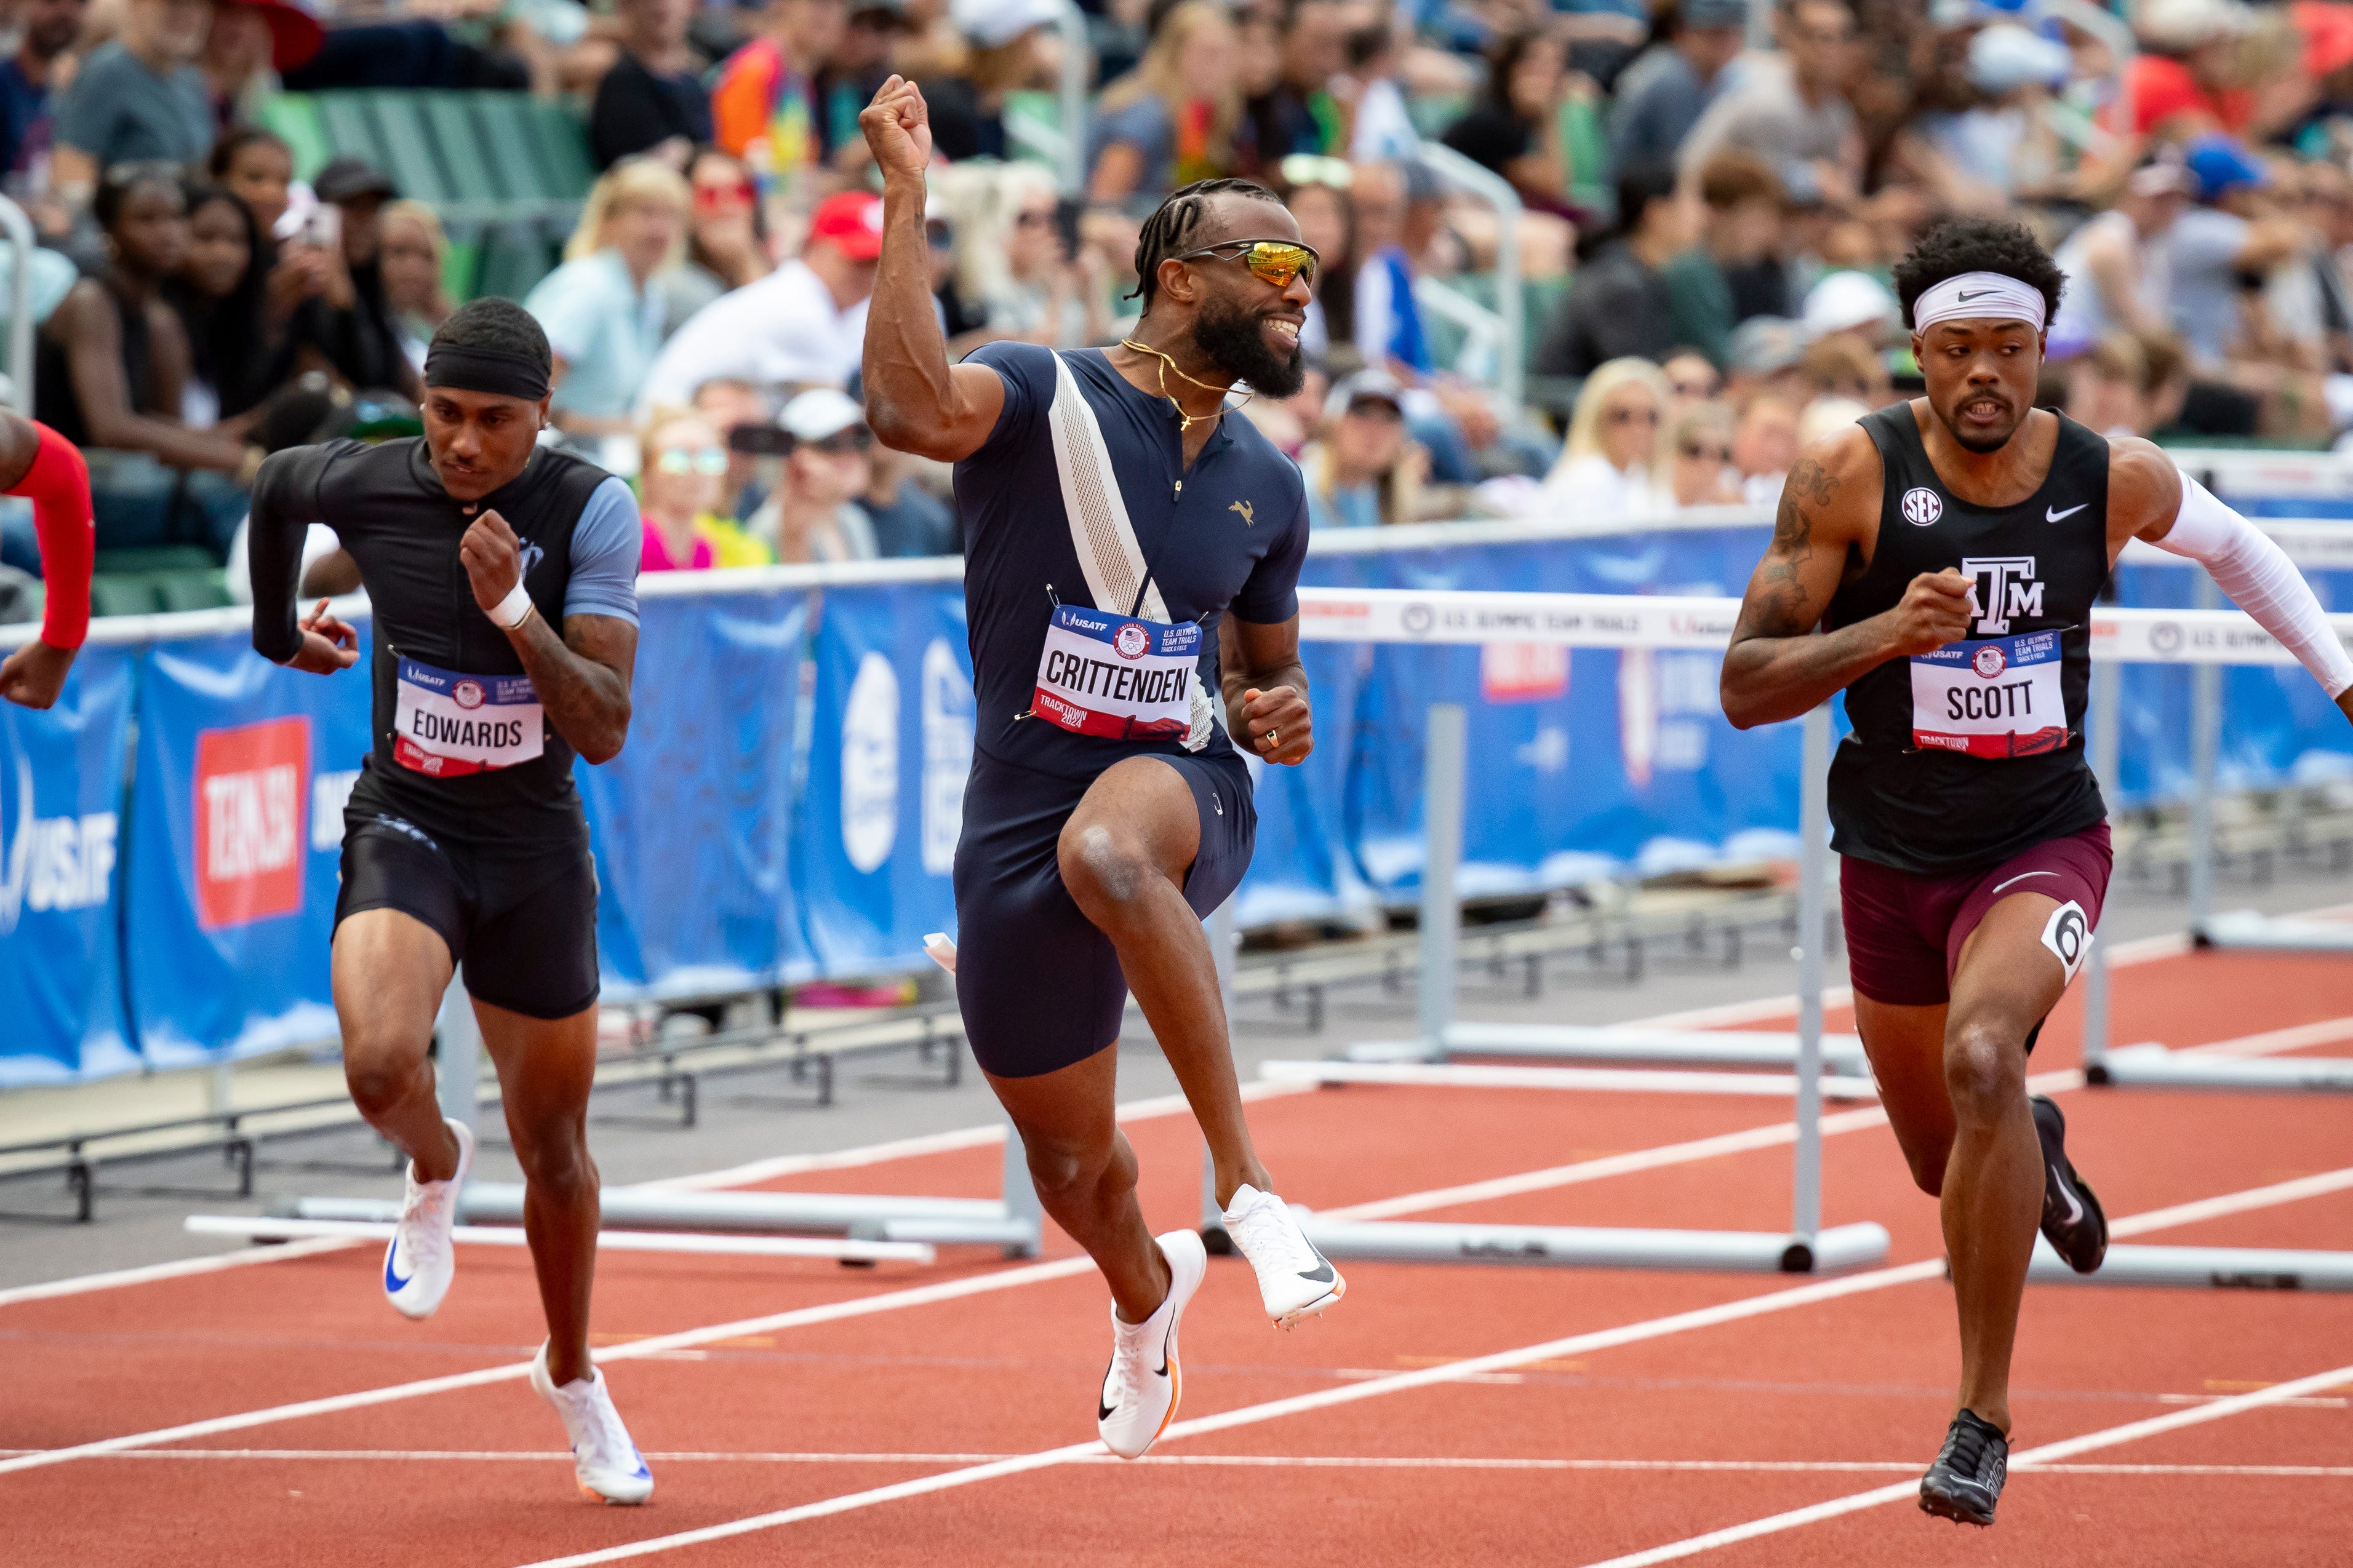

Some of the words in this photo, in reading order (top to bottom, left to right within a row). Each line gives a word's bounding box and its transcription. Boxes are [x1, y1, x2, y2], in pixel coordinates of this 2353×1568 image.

[1904, 490, 1940, 523] SEC
[1074, 618, 1108, 631] USATF
[1164, 629, 1175, 638] U.S.
[1175, 626, 1197, 637] OLYMPIC
[1162, 637, 1178, 646] TEAM
[1178, 635, 1197, 645] TRIALS
[2015, 639, 2026, 648] U.S.
[2015, 646, 2031, 656] TEAM
[2032, 640, 2053, 653] TRIALS
[1933, 650, 1963, 659] USATF
[1046, 650, 1189, 703] CRITTENDEN
[1041, 694, 1087, 720] TRACKTOWN
[1946, 679, 2033, 720] SCOTT
[413, 707, 522, 748] EDWARDS
[1061, 714, 1083, 728] 2024
[2055, 909, 2085, 966] 6
